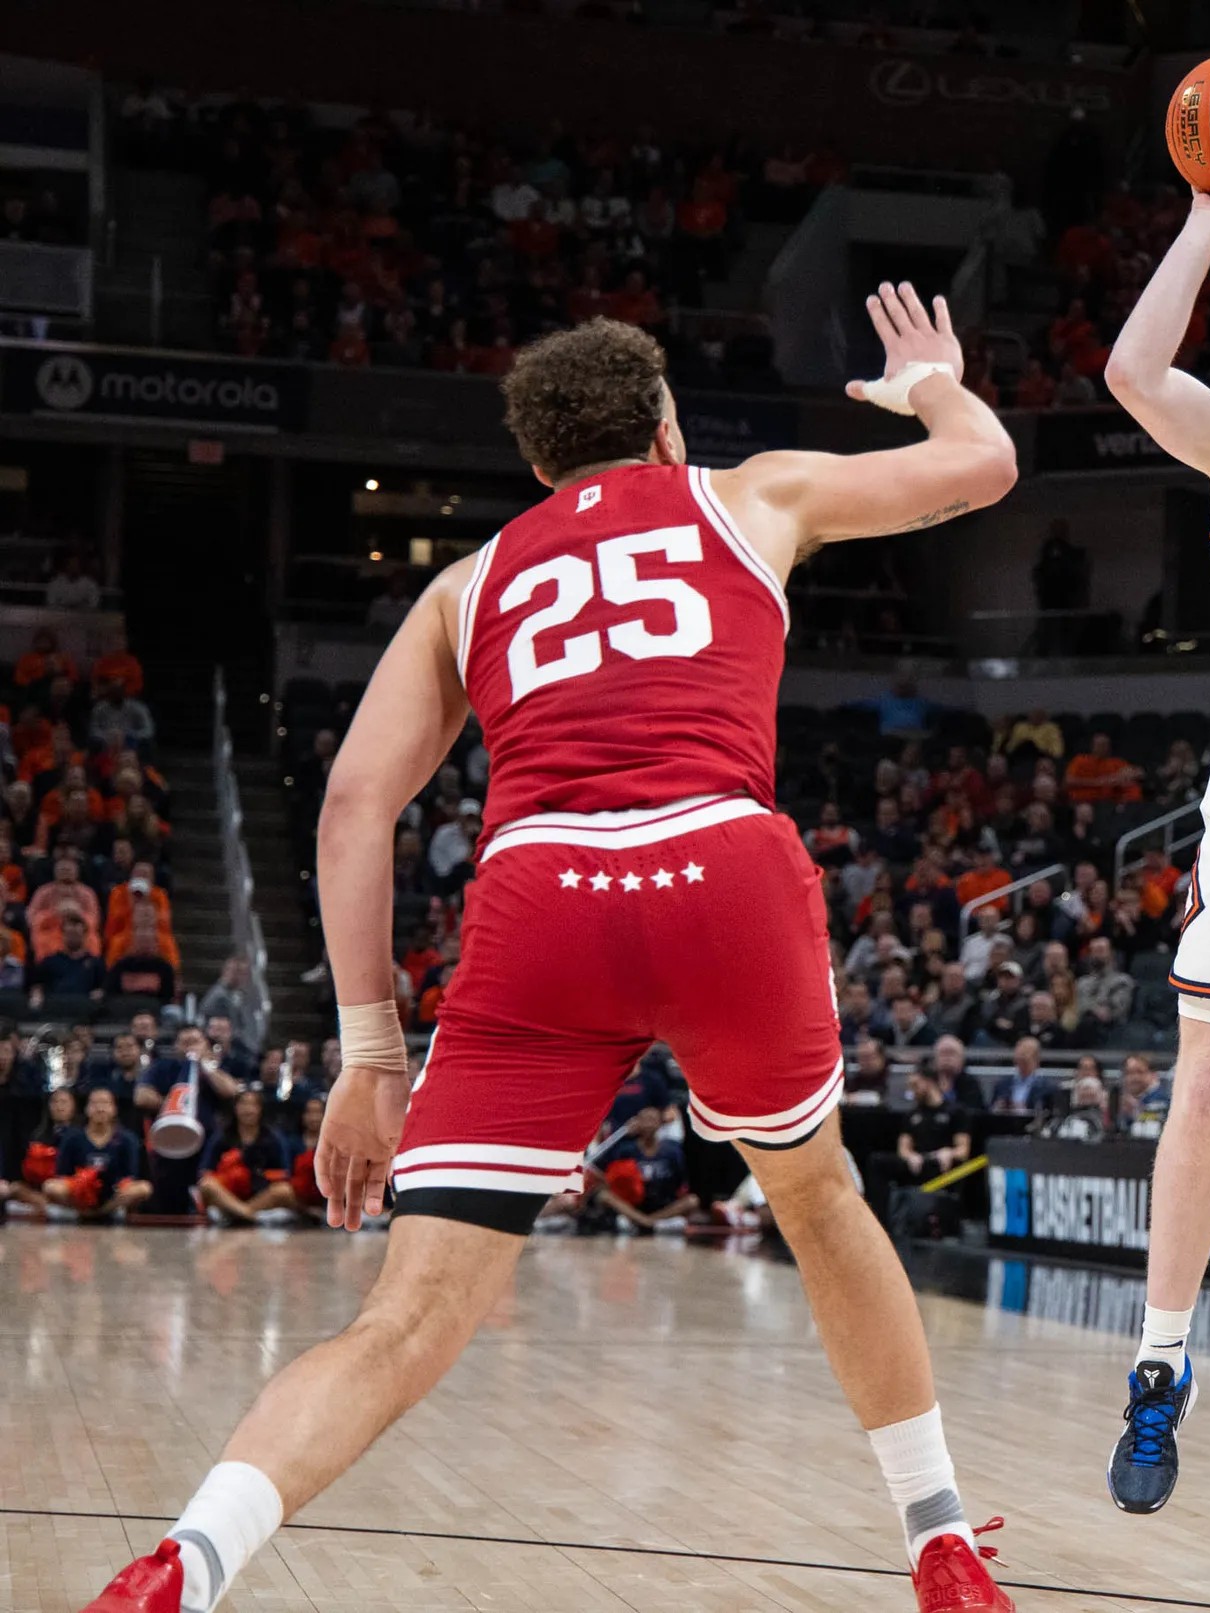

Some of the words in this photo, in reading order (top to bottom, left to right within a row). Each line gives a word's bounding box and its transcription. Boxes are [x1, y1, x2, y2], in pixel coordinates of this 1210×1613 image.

[1186, 80, 1207, 166] LEGACY
[102, 370, 279, 411] motorola
[499, 524, 714, 705] 25
[1031, 1173, 1149, 1250] BASKETBALL
